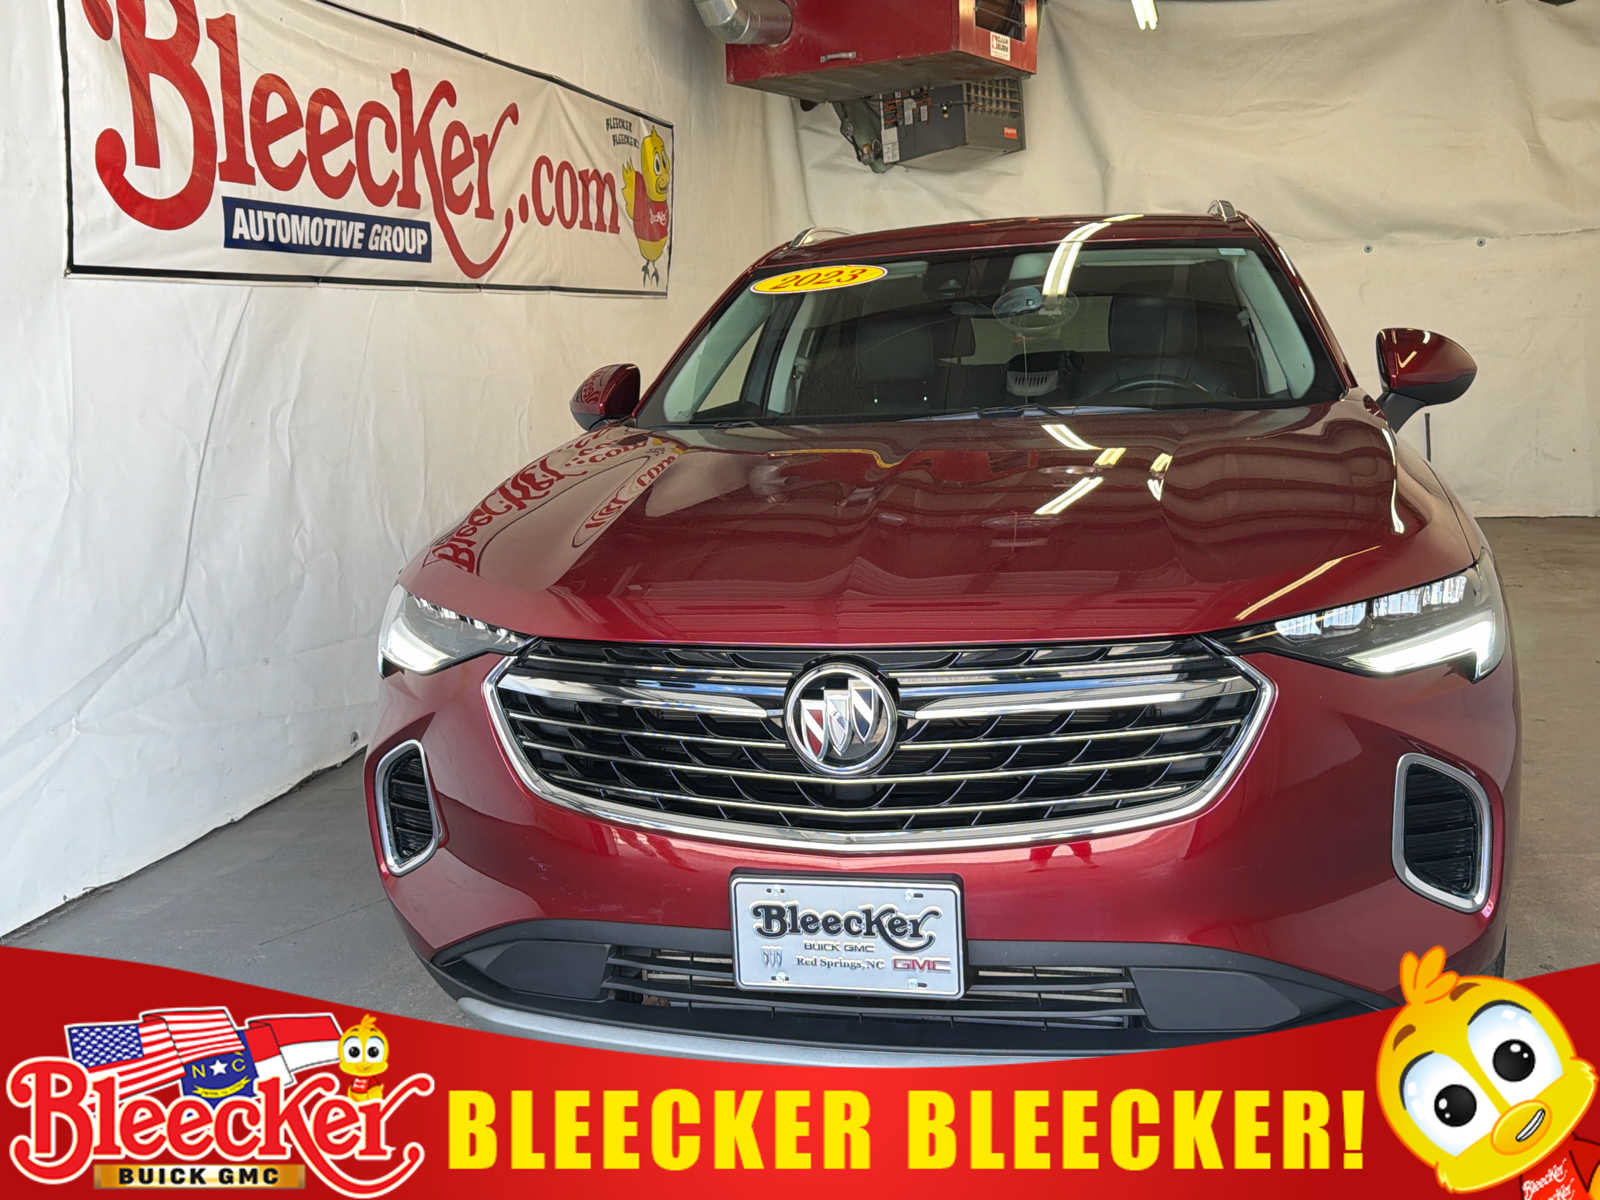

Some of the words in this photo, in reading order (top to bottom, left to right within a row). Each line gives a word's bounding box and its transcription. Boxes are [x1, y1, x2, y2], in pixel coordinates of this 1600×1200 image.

[232, 207, 365, 250] AUTOMOTIVE
[368, 225, 429, 255] GROUP
[769, 268, 867, 290] 2023
[752, 904, 941, 952] Bleecker
[804, 942, 840, 952] BUICK
[844, 943, 875, 953] GMC
[797, 957, 817, 968] Red
[893, 957, 952, 972] GMC
